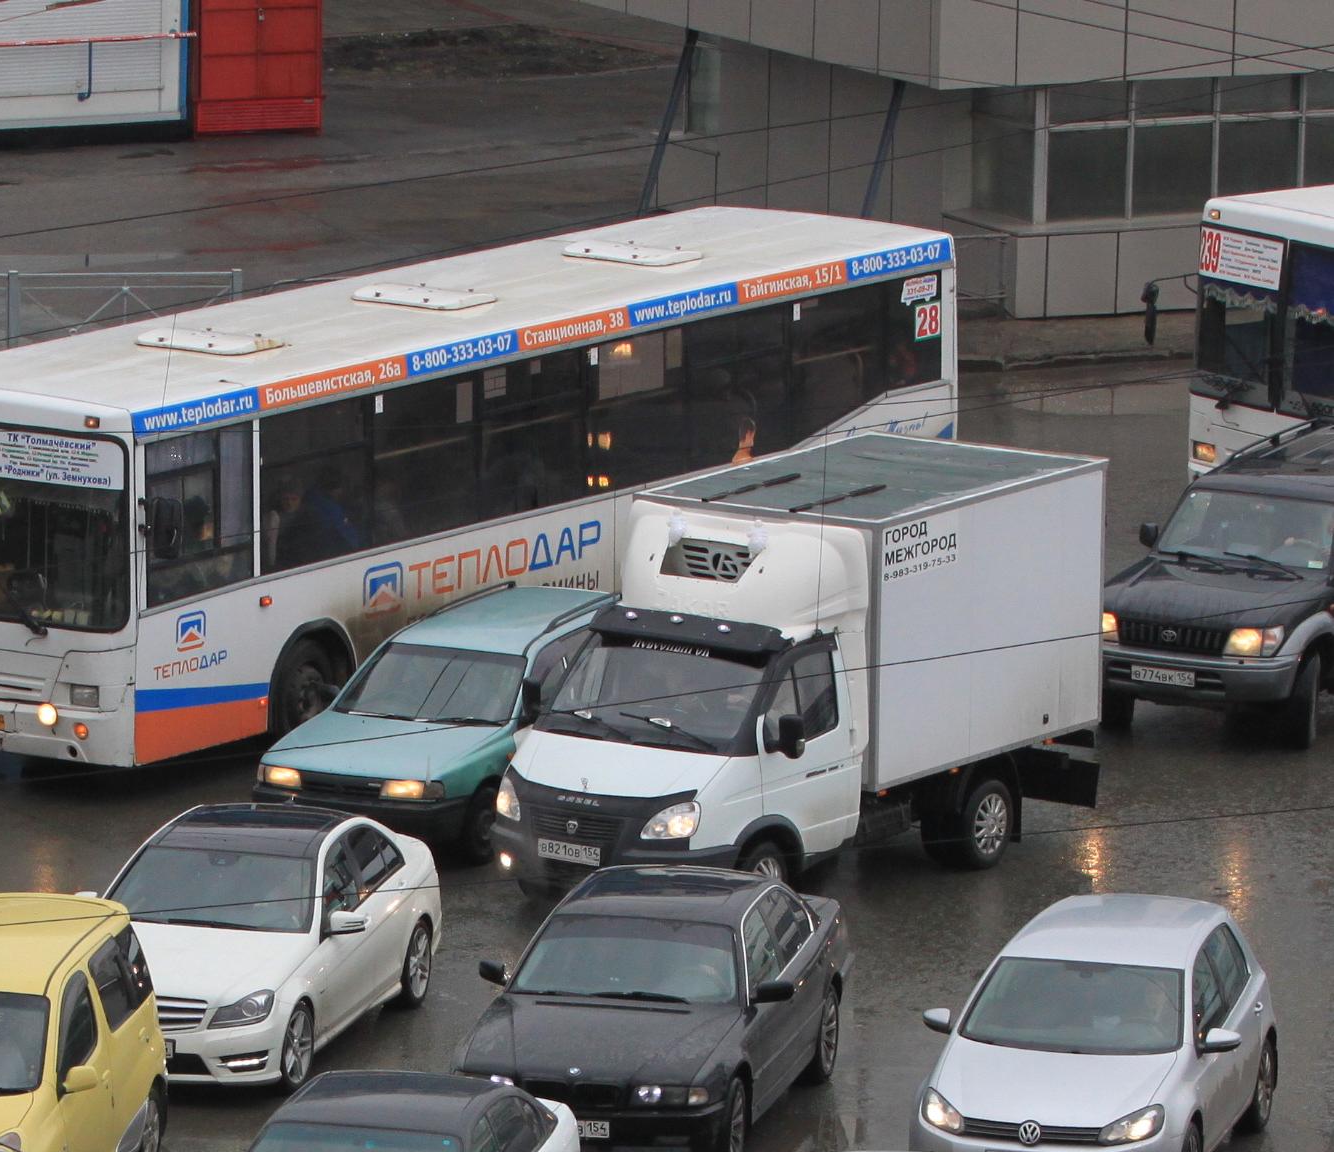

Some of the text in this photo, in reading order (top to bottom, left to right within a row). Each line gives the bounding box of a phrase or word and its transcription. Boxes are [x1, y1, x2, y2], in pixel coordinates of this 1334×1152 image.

[851, 243, 942, 277] 8-800-333-03-07
[1199, 229, 1222, 274] 239
[741, 265, 843, 300] Тайгинская, 15/1
[634, 287, 732, 323] www.teplodar.ru
[916, 305, 939, 338] 28
[523, 310, 625, 347] Станционная, 38
[411, 331, 514, 373] 8-800-333-03-07
[264, 361, 402, 405] Большевистская, 26а
[143, 393, 254, 432] www.teplodar.ru
[7, 432, 19, 443] ТК
[62, 471, 112, 487] Земнухова)
[884, 532, 957, 567] МЕЖГОРОД
[885, 521, 928, 546] ГОРОД
[409, 520, 601, 600] ТЕПЛОДАР
[153, 649, 228, 681] ТЕПЛОДАР
[540, 841, 600, 858] В821ОВ 154
[587, 1121, 607, 1133] 154
